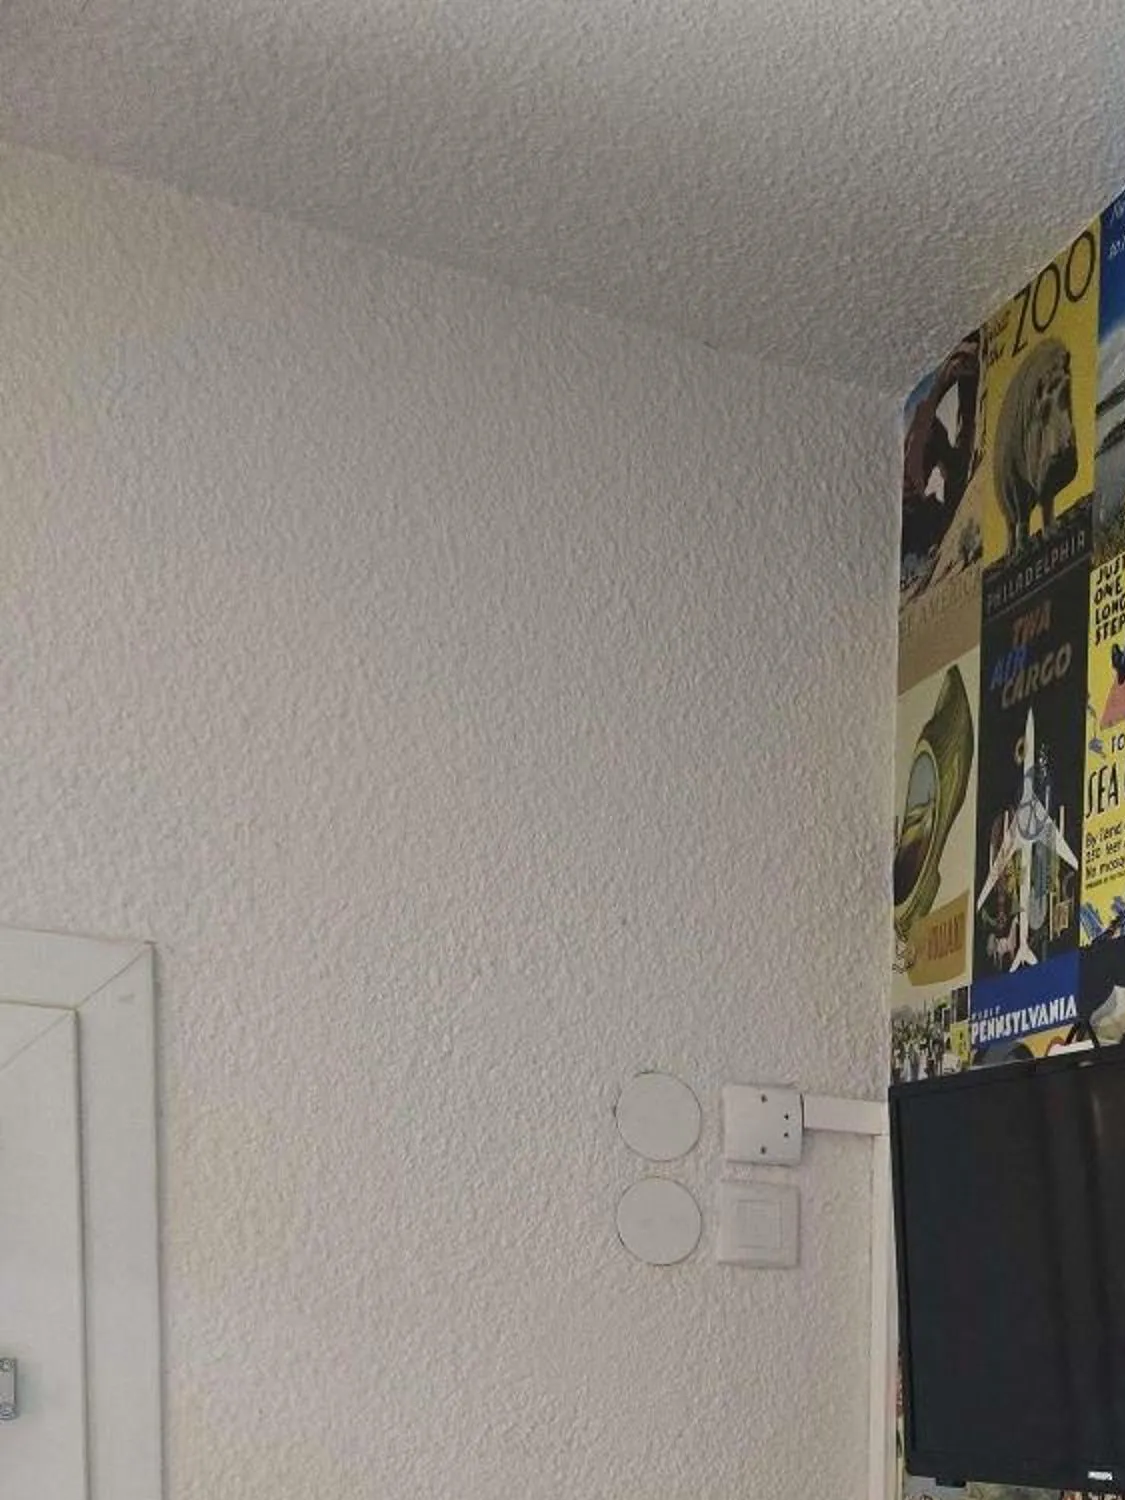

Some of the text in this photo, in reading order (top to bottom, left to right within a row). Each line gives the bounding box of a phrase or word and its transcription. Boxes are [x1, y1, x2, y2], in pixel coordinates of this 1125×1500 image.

[1012, 230, 1096, 358] ZOO
[987, 530, 1086, 615] PHILADELPHIA
[1002, 642, 1072, 709] CARGO
[1086, 763, 1119, 819] SEA
[971, 994, 1077, 1045] PENNSYLVANIA
